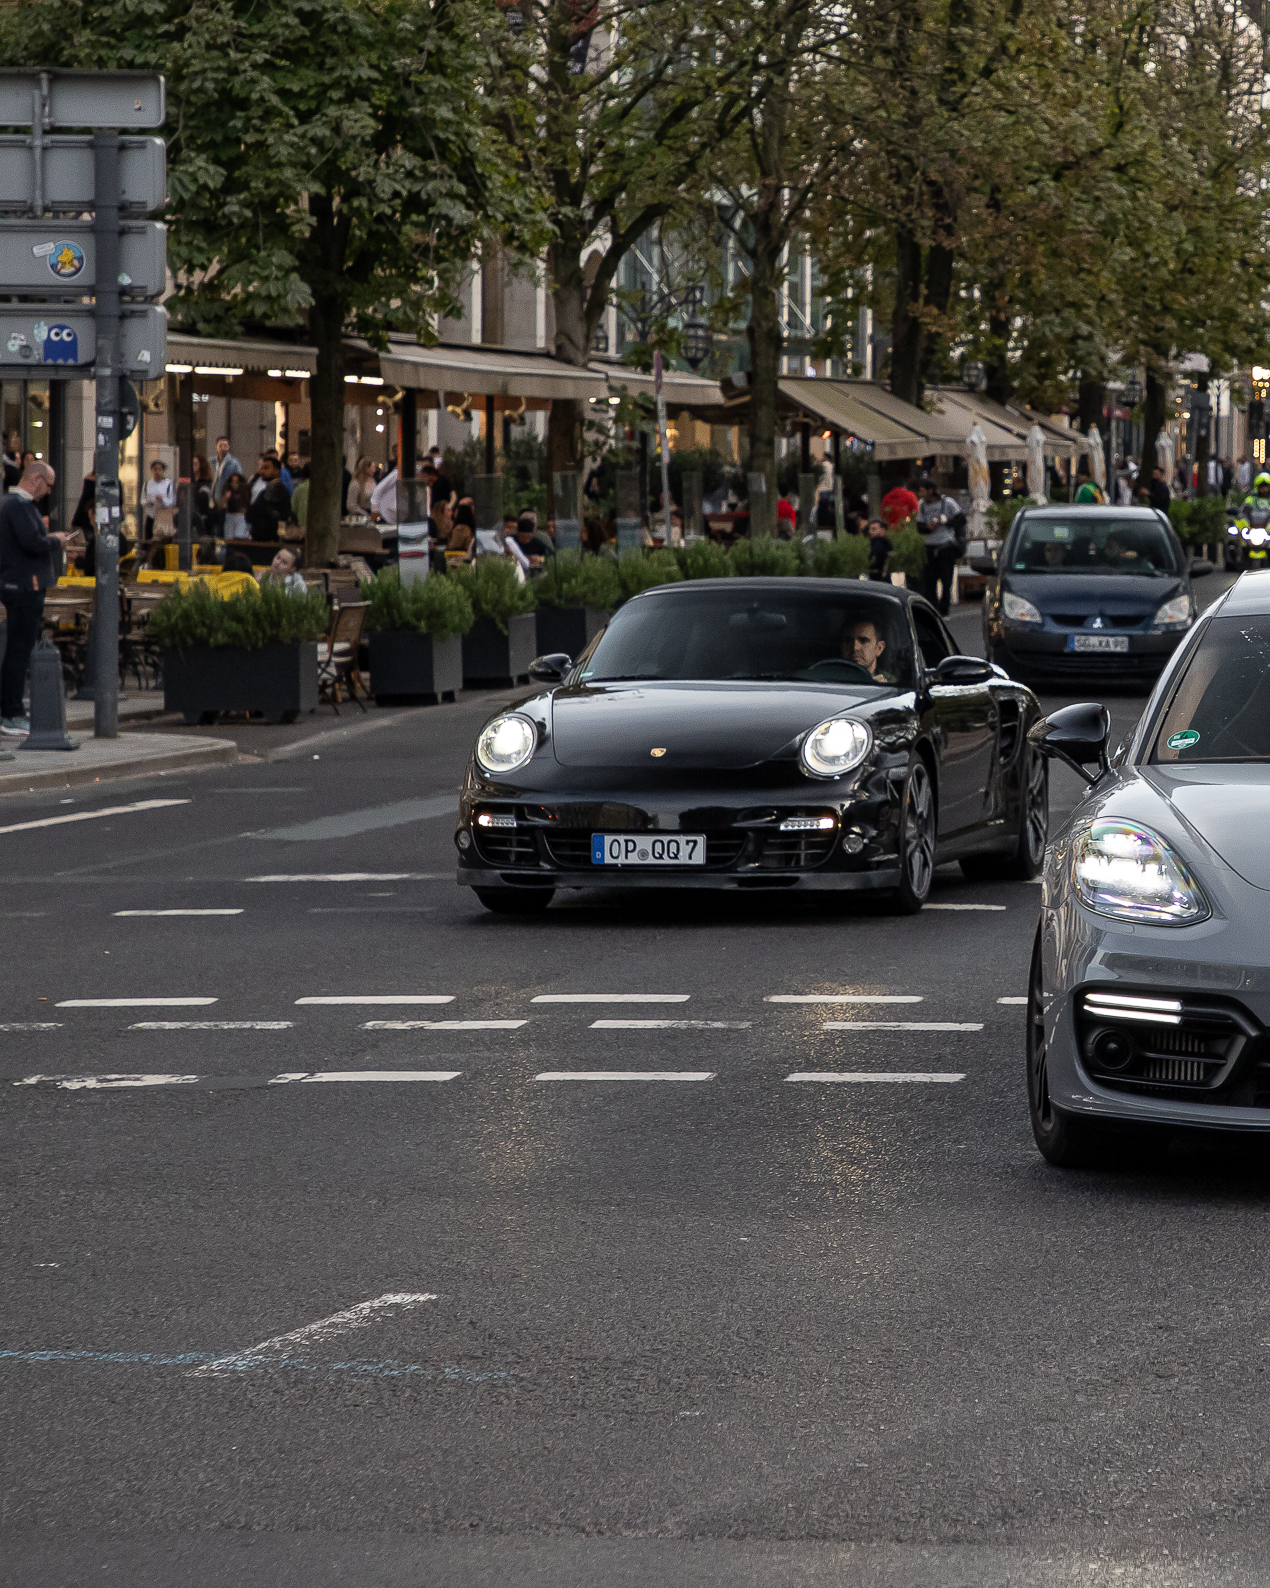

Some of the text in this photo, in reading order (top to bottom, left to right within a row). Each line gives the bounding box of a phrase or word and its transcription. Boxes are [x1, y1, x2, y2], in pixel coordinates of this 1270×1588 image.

[609, 839, 698, 860] OP QQ 7
